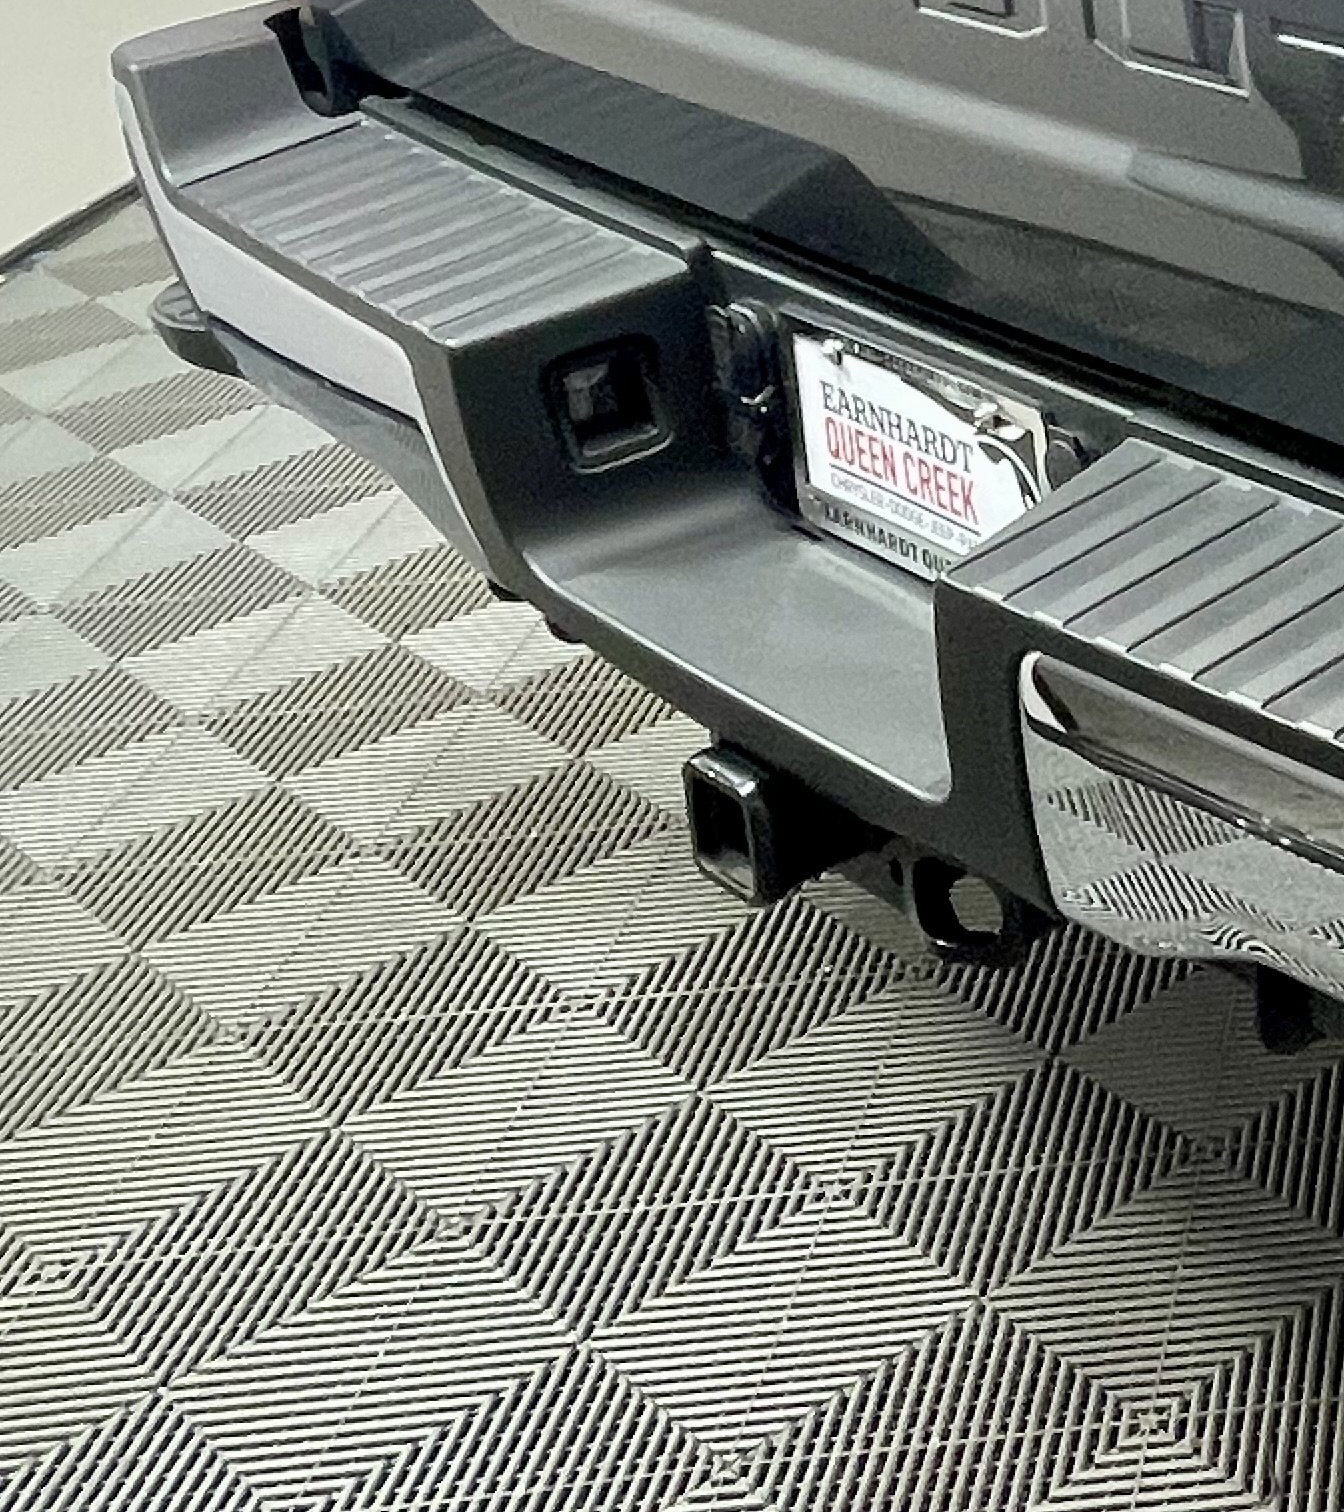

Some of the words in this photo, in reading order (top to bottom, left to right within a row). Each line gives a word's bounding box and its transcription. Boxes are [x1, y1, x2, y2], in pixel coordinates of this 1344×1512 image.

[819, 380, 974, 474] EARNHARDT
[824, 416, 898, 487] QUEEN
[902, 450, 980, 526] CREEK
